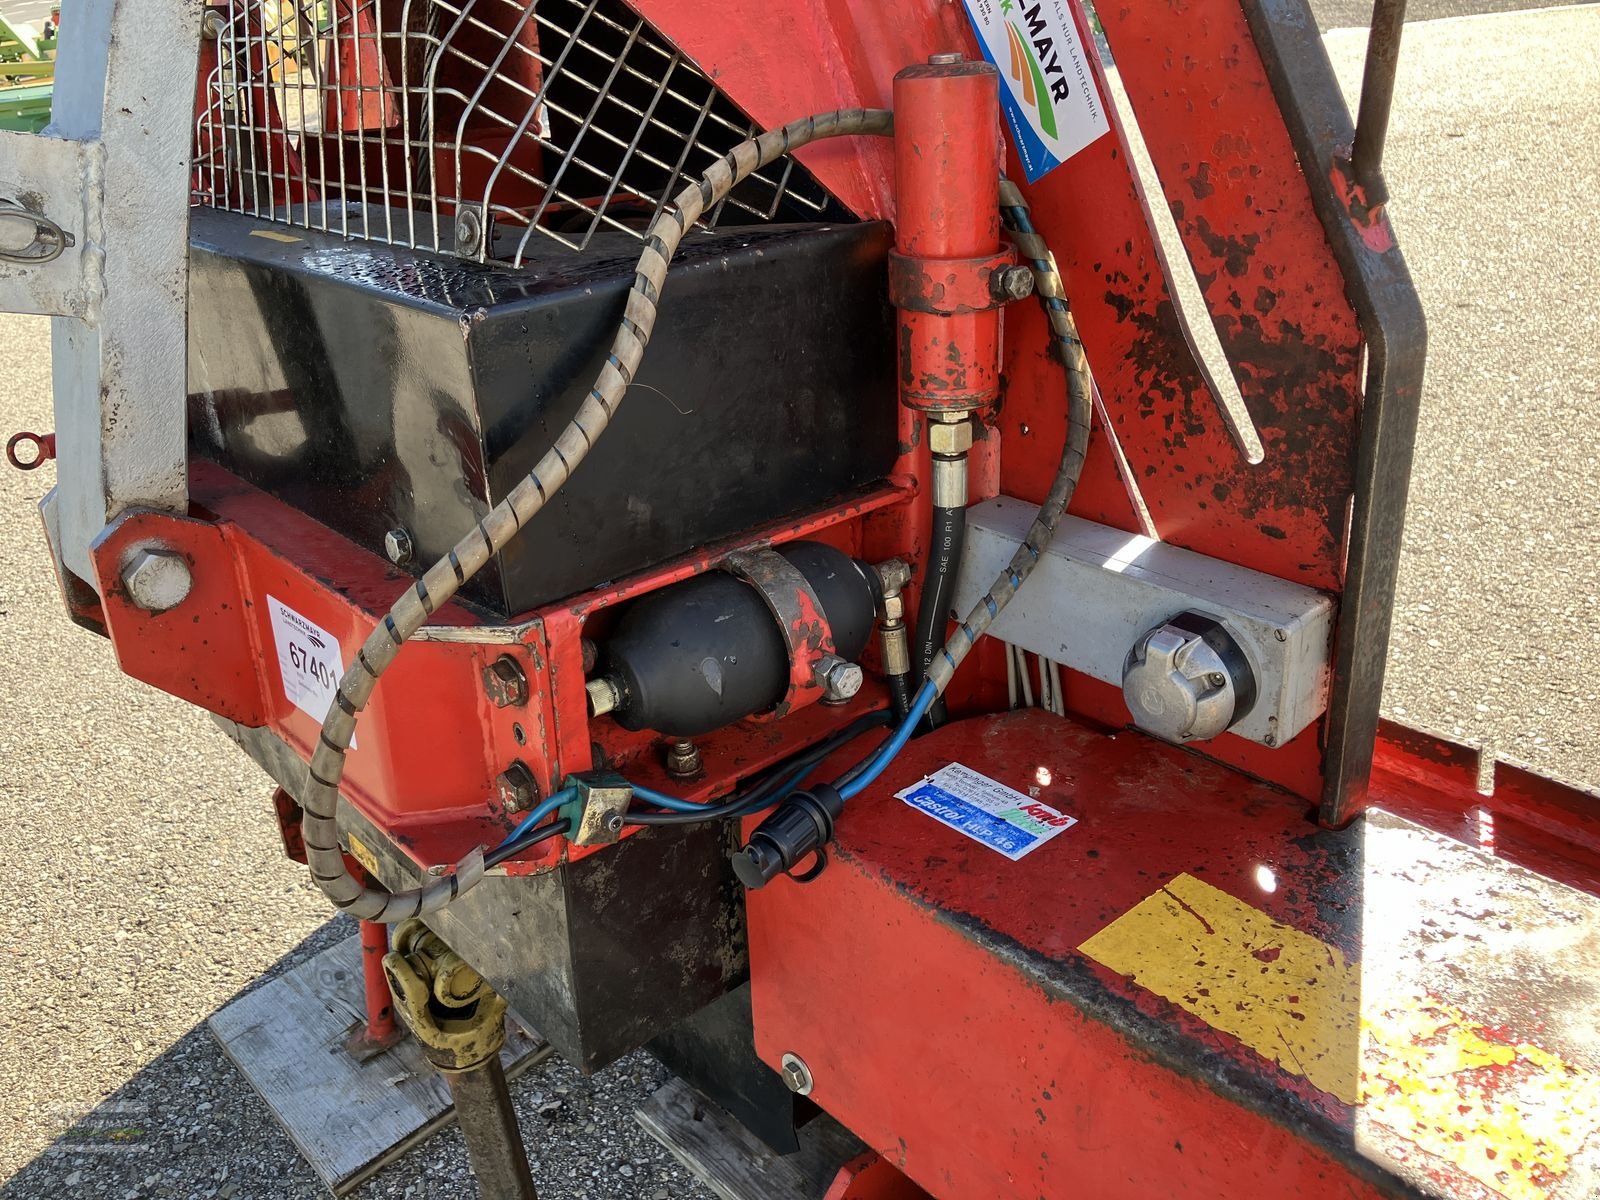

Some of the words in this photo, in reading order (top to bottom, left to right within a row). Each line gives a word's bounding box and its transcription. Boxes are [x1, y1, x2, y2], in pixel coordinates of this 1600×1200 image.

[1053, 1, 1065, 22] ALS
[1061, 23, 1073, 46] NUR
[1069, 47, 1098, 124] LANDTECHNIK.
[945, 521, 953, 532] R1
[943, 536, 952, 551] 100
[939, 555, 949, 573] SAE
[280, 607, 321, 639] SCHWARZMAYR
[924, 641, 933, 655] DIN
[289, 641, 338, 692] 67401
[924, 657, 931, 666] 12
[993, 787, 1022, 802] GmbH
[913, 795, 965, 821] Castrol
[963, 820, 993, 837] HLP
[994, 836, 1016, 850] 46
